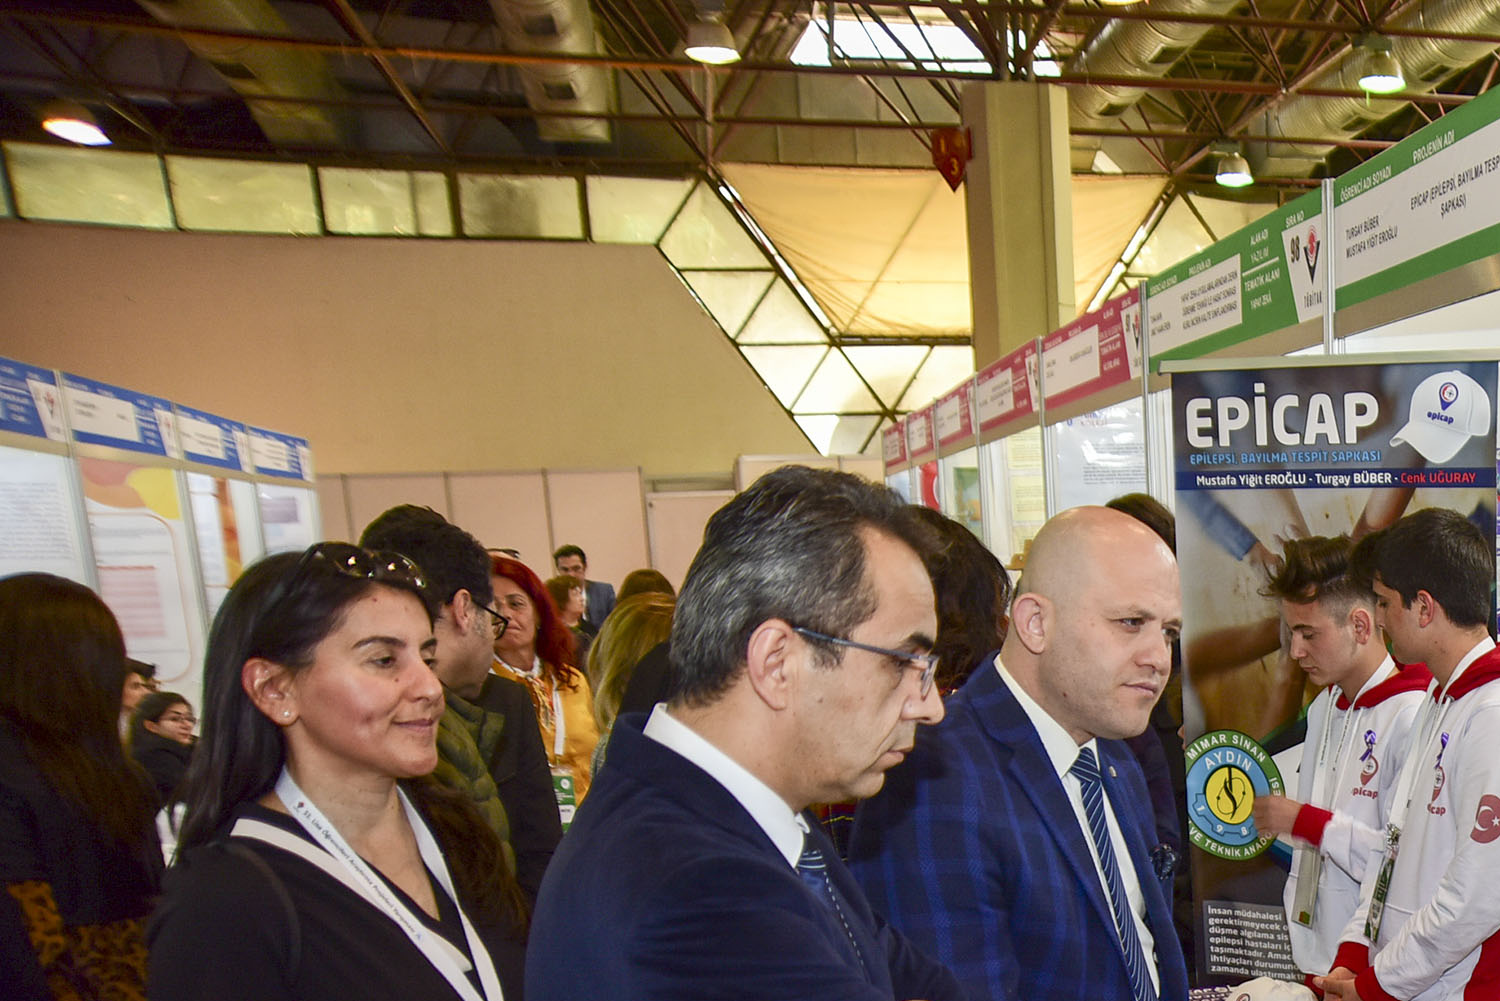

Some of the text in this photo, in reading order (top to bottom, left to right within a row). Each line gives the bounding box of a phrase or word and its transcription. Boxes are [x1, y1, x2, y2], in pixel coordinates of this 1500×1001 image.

[1412, 129, 1455, 164] PROJENİN ADI
[1457, 165, 1484, 190] BAYILMA
[1290, 235, 1300, 263] 98
[1185, 382, 1380, 448] EPİCAP
[1426, 410, 1455, 425] epicap
[1241, 451, 1288, 464] BAYILMA
[1196, 469, 1477, 488] Mustafa Yiğit EROĞLU Turgay BÜBER Cenk UĞURAY
[1186, 733, 1267, 763] MİMAR SİNAN
[1204, 750, 1252, 771] AYDIN
[1351, 786, 1379, 800] picap
[1189, 826, 1203, 842] VE
[1204, 837, 1242, 858] TEKNİK
[1234, 909, 1282, 921] müdahalesi
[1208, 917, 1281, 931] gerektirmeyecek
[1208, 926, 1239, 937] düşme
[1240, 930, 1275, 940] algılama
[1209, 936, 1244, 946] epilepsi
[1245, 939, 1282, 951] hastaları
[1210, 945, 1266, 958] taşımaktadır.
[1210, 964, 1250, 976] zamanda
